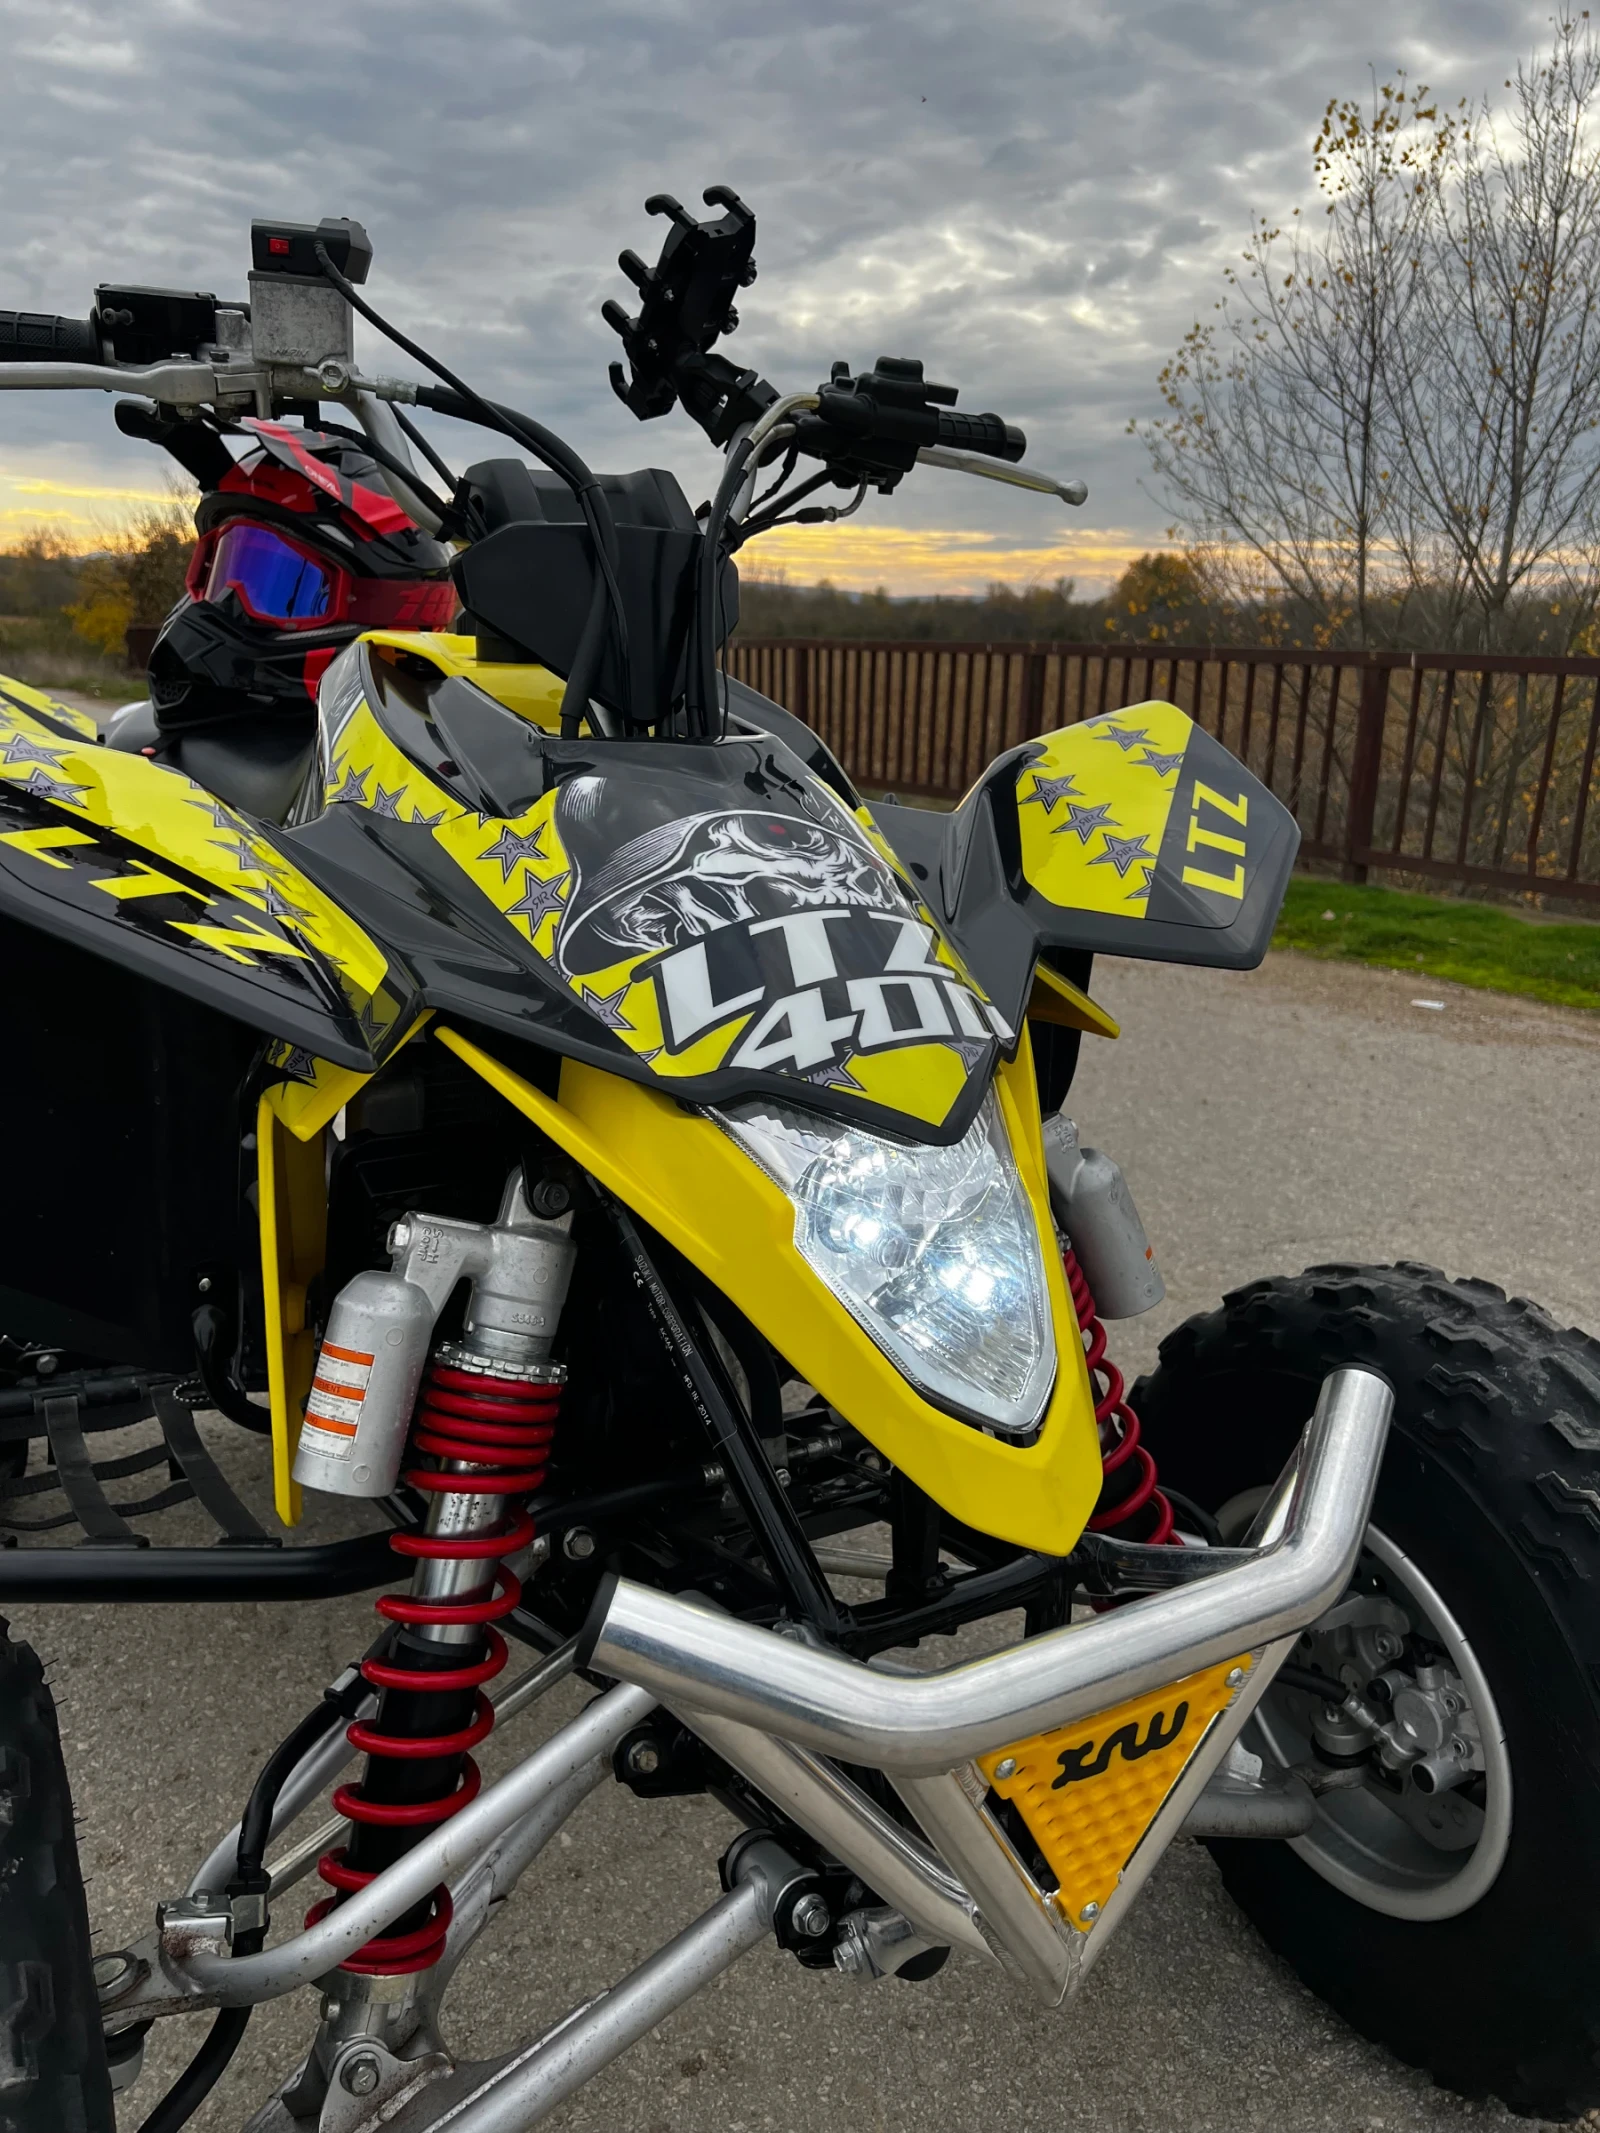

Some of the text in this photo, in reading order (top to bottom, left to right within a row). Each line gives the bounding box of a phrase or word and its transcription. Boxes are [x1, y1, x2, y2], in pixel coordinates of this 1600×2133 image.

[0, 826, 314, 966] LTZ
[1182, 780, 1248, 900] LTZ
[657, 909, 955, 1048] LTZ
[634, 1254, 693, 1357] SUZUKI MOTOR CORPORATION
[698, 1404, 713, 1427] 2014
